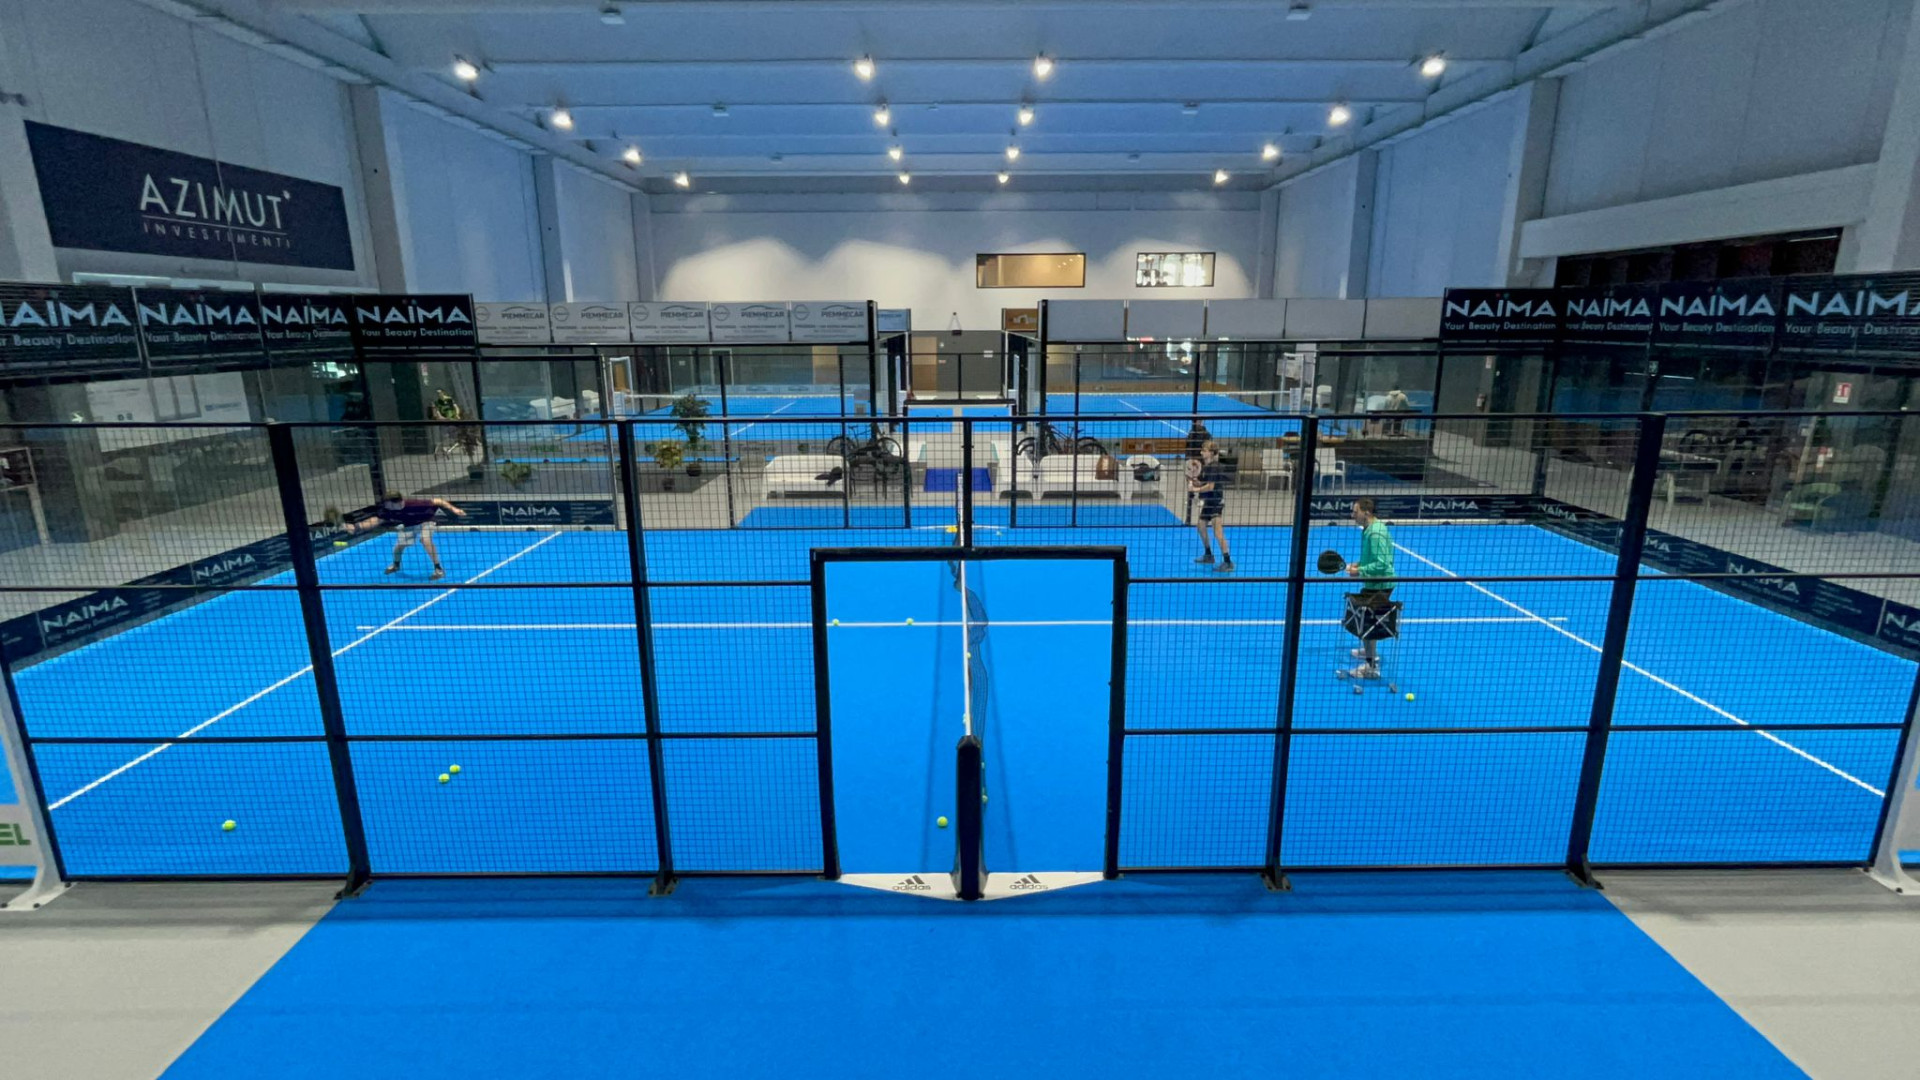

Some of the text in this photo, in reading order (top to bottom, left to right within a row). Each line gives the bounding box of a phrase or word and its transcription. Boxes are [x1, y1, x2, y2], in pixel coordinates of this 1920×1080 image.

[140, 173, 283, 230] AZIMUT
[143, 222, 292, 249] INVESTIMENTI
[0, 300, 132, 327] AIMA
[138, 303, 258, 326] NAIMA
[262, 305, 348, 324] NAIMA
[1445, 299, 1557, 318] NAIMA
[1566, 298, 1651, 317] NAIMA
[1660, 294, 1776, 316] NAIMA
[356, 306, 471, 324] NAIMA
[384, 328, 416, 338] Beauty
[420, 328, 473, 337] Destination
[1469, 321, 1500, 332] Beauty
[1504, 321, 1556, 331] Destination
[501, 506, 560, 516] NAIMA
[1310, 501, 1353, 510] NAIM
[1421, 500, 1479, 510] NAIMA
[195, 553, 256, 580] NAIMA
[42, 595, 129, 634] NAIMA
